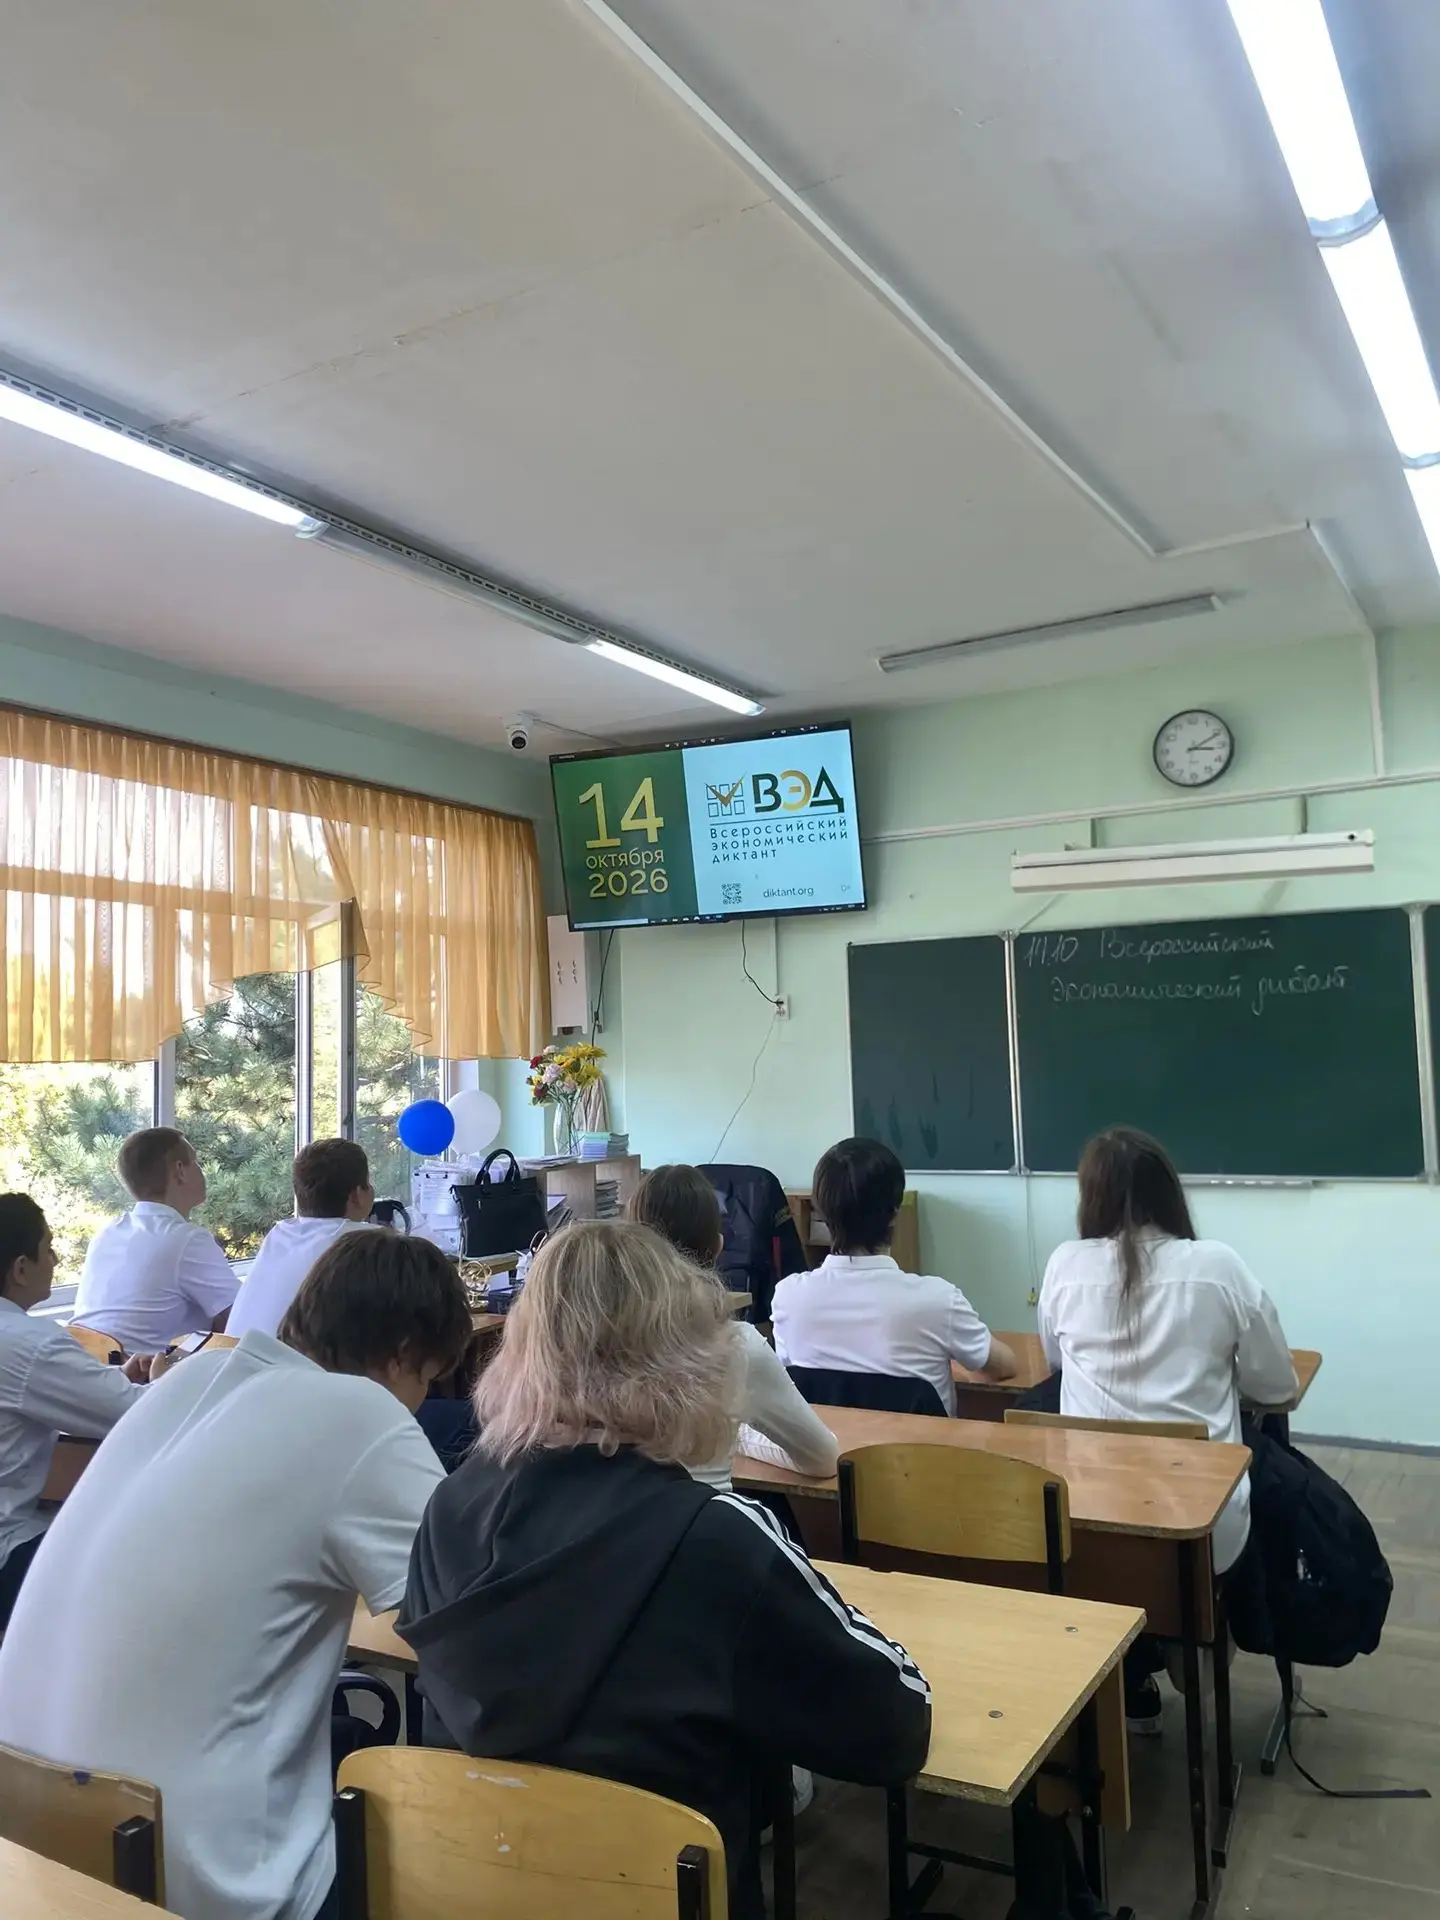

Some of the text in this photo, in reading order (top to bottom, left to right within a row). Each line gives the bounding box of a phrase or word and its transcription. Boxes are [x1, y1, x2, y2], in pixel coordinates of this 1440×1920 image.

[752, 766, 845, 813] ВЭД
[579, 777, 664, 849] 14
[710, 817, 847, 839] Всероссийский
[711, 828, 849, 851] экономический
[586, 847, 664, 869] октября
[712, 849, 777, 864] диктант
[588, 868, 669, 898] 2026
[763, 886, 815, 899] diktant.org
